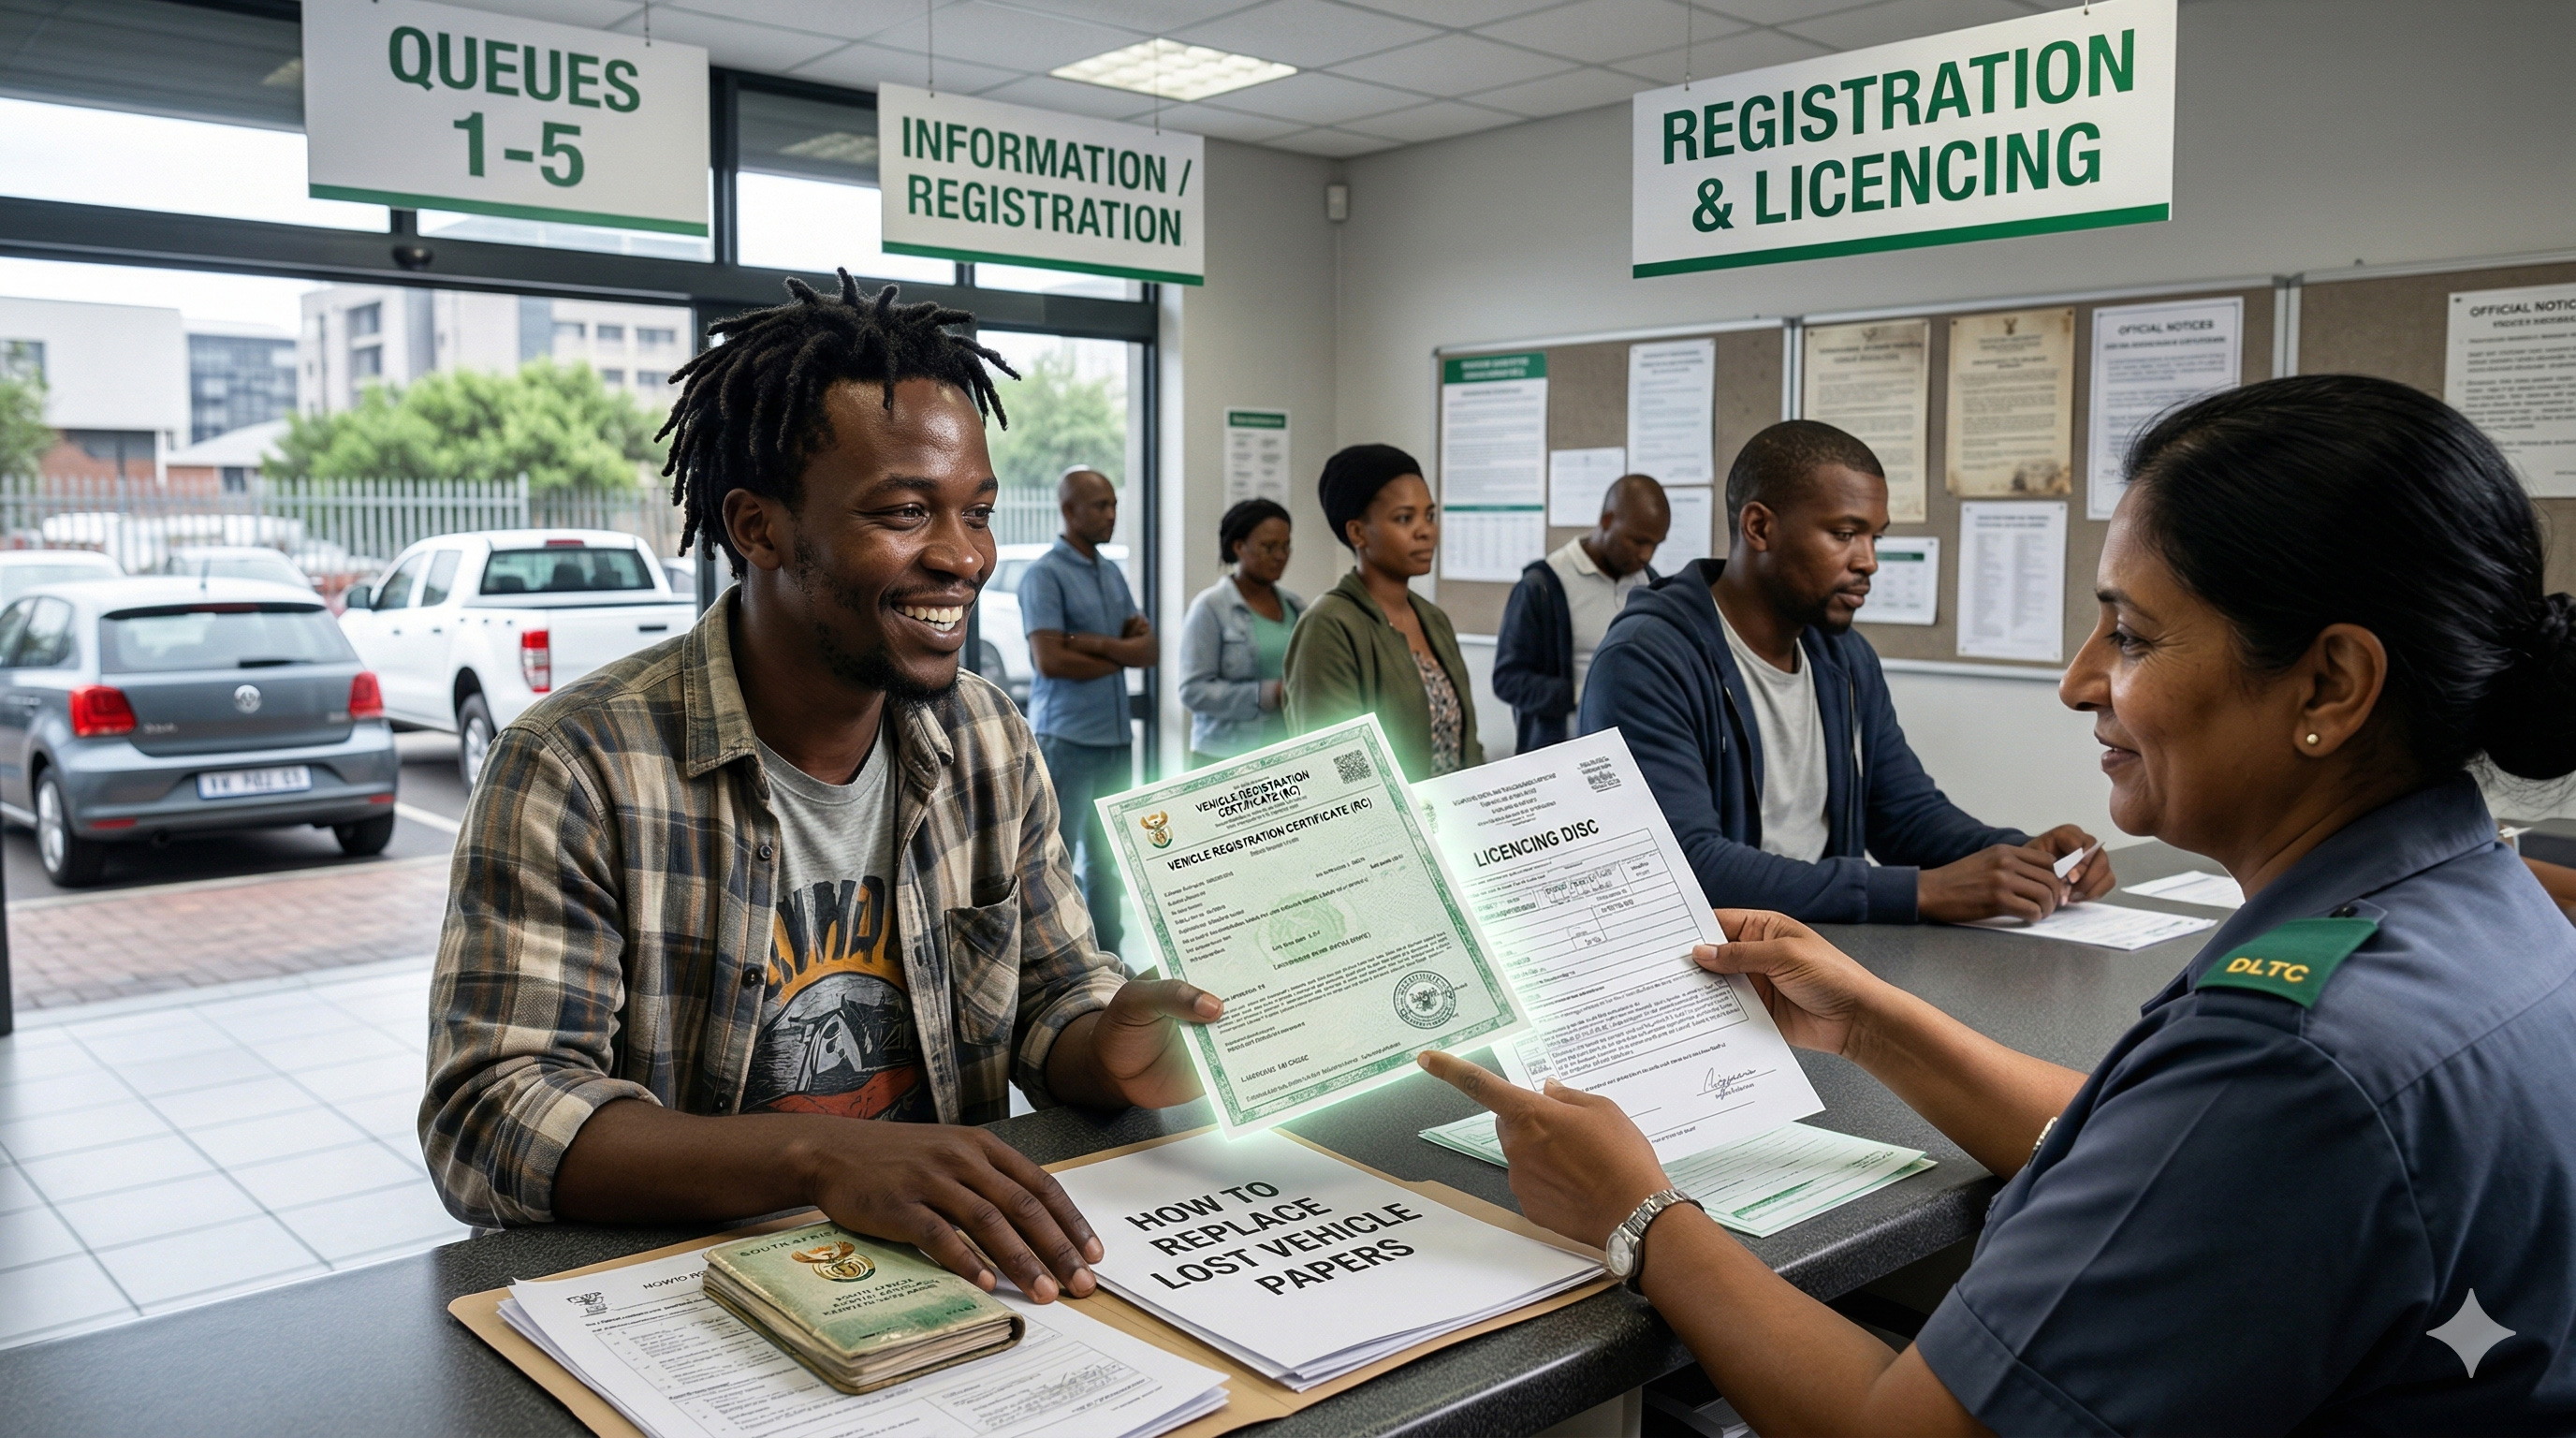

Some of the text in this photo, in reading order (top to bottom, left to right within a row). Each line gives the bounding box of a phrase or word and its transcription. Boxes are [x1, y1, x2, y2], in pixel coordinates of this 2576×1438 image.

[389, 25, 641, 113] QUEUES
[1662, 28, 2135, 166] REGISTRATION
[453, 110, 585, 188] 1-5
[902, 115, 1193, 198] INFORMATION /
[1691, 122, 2101, 233] & LICENCING
[908, 173, 1181, 247] REGISTRATION
[2469, 302, 2531, 317] OFFICIAL
[1211, 825, 1285, 858] REGISTRATION
[1285, 804, 1350, 834] CERTIFICATE
[1350, 796, 1372, 814] (RC)
[1473, 818, 1599, 868] LICENCING DISC
[2226, 957, 2310, 983] DLTC
[1124, 1181, 1280, 1232] HOW TO
[1149, 1196, 1333, 1257] REPLACE
[1150, 1202, 1424, 1290] LOST VEHICLE
[1254, 1239, 1415, 1296] PAPERS
